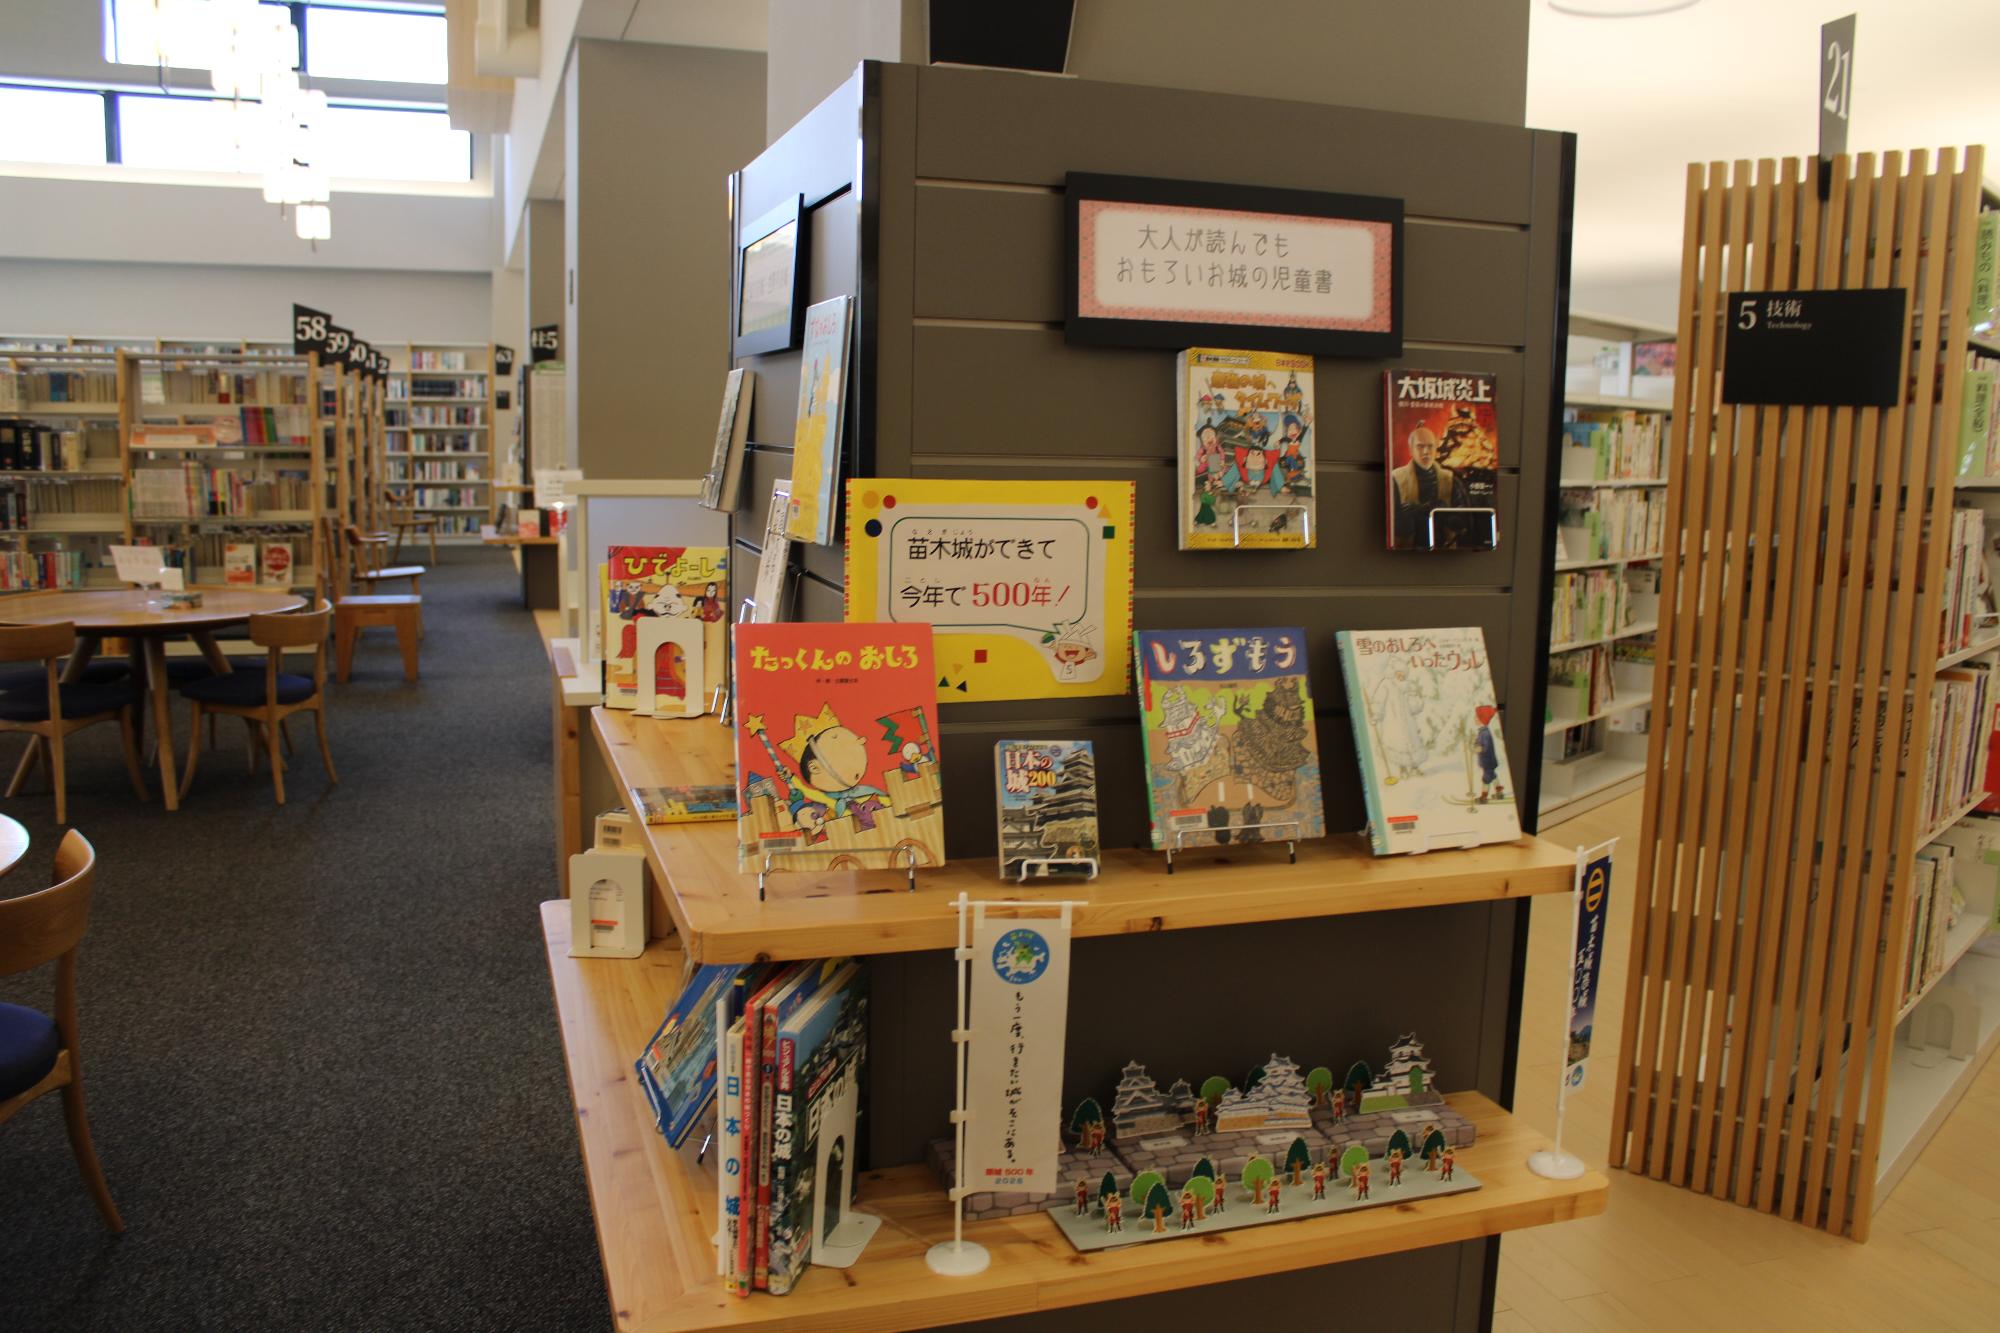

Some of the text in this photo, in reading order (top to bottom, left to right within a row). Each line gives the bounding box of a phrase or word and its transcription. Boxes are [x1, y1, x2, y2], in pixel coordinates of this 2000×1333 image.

[1824, 41, 1850, 120] 21
[1138, 224, 1290, 258] 大人が読んでも
[1116, 256, 1333, 294] おもろいお城の児童書
[296, 315, 327, 341] 58
[1738, 299, 1802, 330] 5 技術
[325, 332, 350, 353] 59
[908, 537, 1056, 560] 苗木城ができて
[750, 645, 919, 671] たっくんの おしろ
[1151, 636, 1297, 674] しろずもう
[1356, 637, 1436, 656] 雪のおしろへ
